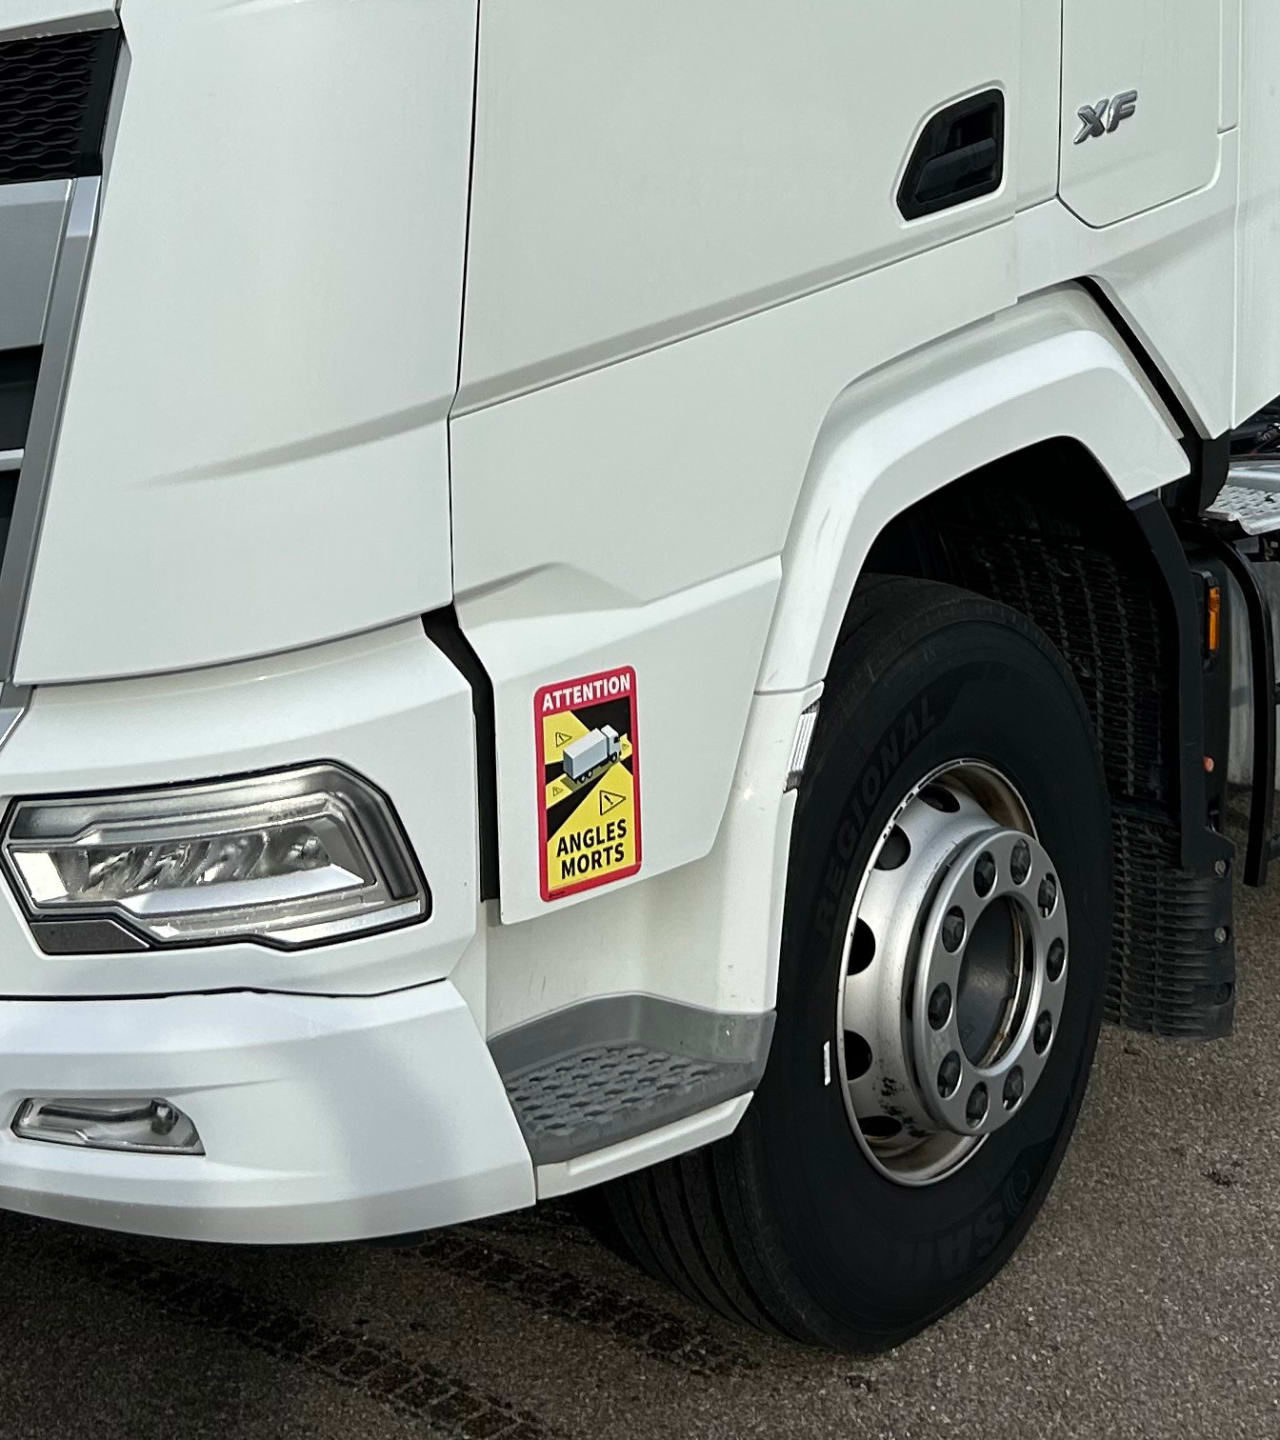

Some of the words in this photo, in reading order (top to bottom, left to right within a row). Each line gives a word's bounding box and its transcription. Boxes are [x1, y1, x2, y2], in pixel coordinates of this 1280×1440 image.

[1072, 89, 1138, 145] XF
[542, 673, 631, 712] ATTENTION
[813, 692, 942, 934] REGIONAL
[556, 818, 627, 858] ANGLES
[560, 842, 625, 880] MORTS
